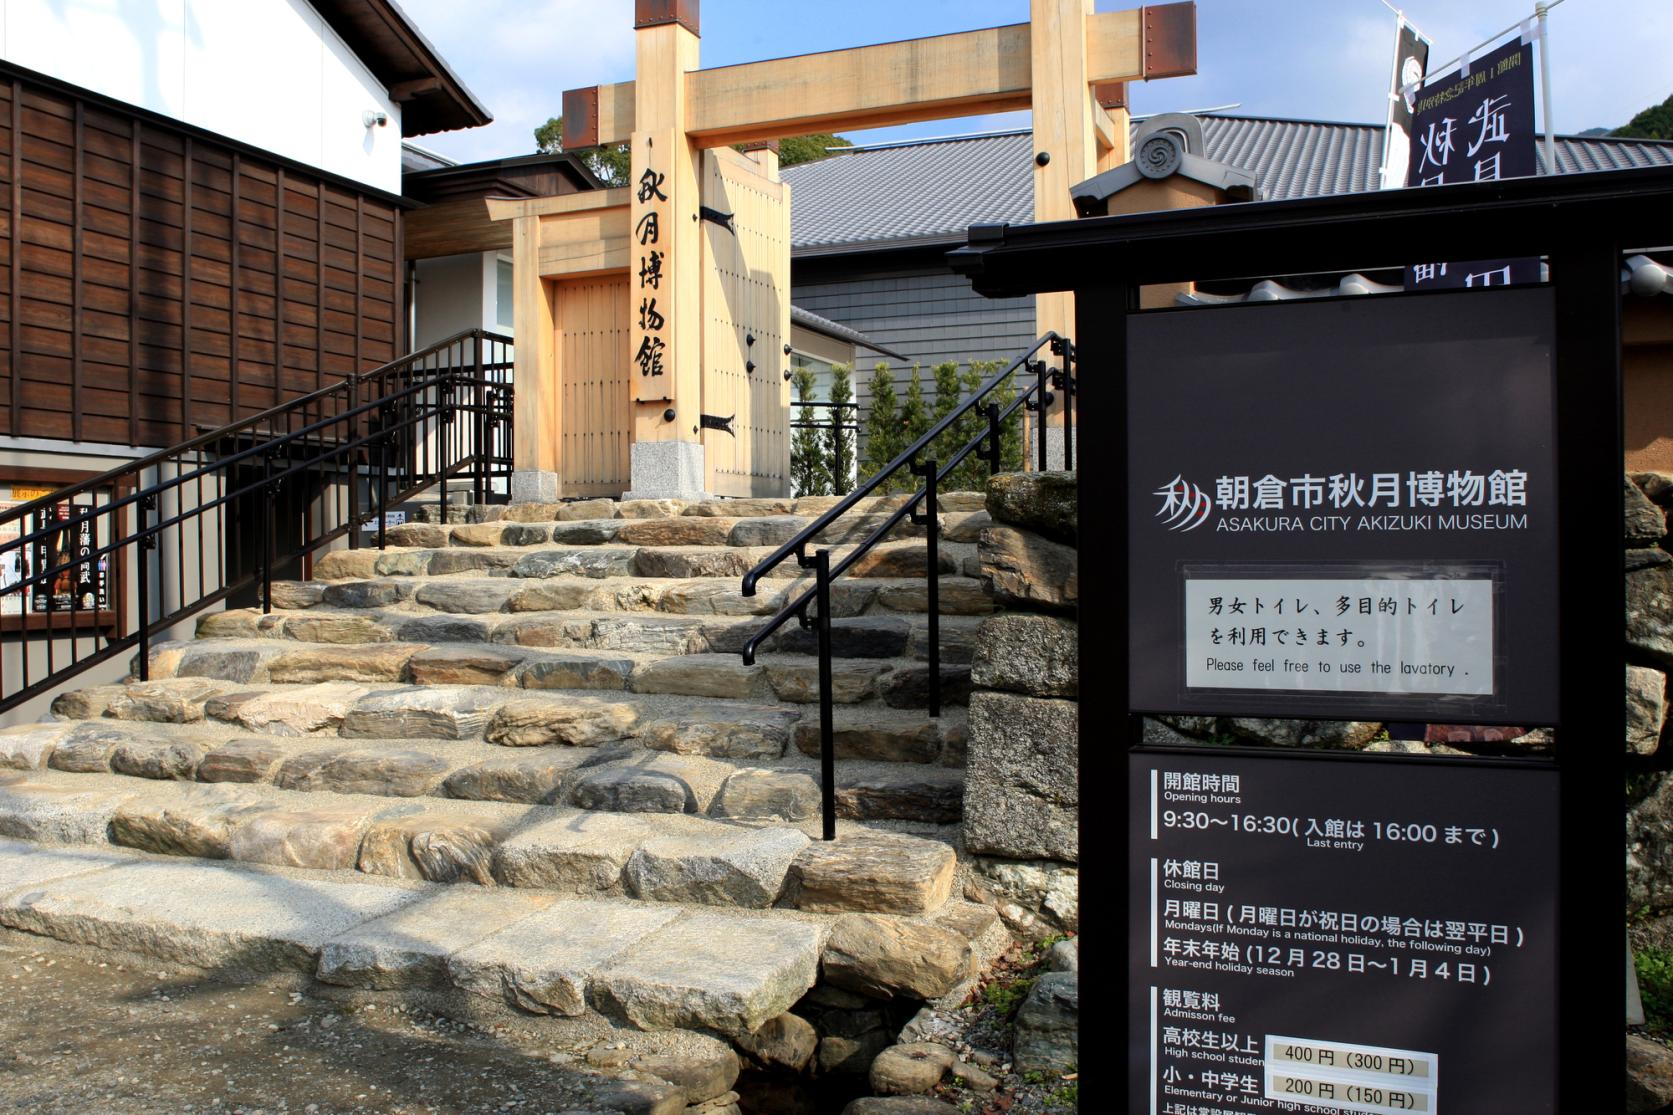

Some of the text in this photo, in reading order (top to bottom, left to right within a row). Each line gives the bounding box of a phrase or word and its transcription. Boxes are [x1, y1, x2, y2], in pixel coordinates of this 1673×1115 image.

[635, 168, 668, 377] 秋月博物館
[1215, 469, 1528, 510] 朝倉市秋月博物館
[1216, 514, 1528, 532] ASAKURA CITY AKIZUKI MUSEUM
[1208, 596, 1464, 616] 男女トイレ、多目的トイレ
[1210, 627, 1365, 647] を利用できます。
[1206, 658, 1244, 671] Please
[1253, 658, 1275, 672] feel
[1284, 659, 1309, 672] free
[1318, 661, 1331, 673] to
[1340, 663, 1361, 674] use
[1371, 660, 1392, 674] the
[1400, 661, 1455, 678] lavatory
[1163, 771, 1240, 794] 開館時間
[1164, 791, 1241, 804] Opening hours
[1307, 837, 1364, 851] Last entry
[1163, 859, 1219, 881] 休館日
[1164, 879, 1225, 894] Closing day
[1227, 924, 1269, 938] Monday
[1272, 928, 1281, 938] is
[1284, 930, 1291, 939] a
[1294, 930, 1338, 943] national
[1387, 937, 1406, 949] the
[1409, 940, 1462, 955] following
[1465, 945, 1491, 957] day)
[1165, 956, 1295, 977] Year-end holiday season
[1163, 988, 1220, 1012] 観覧料
[1164, 1007, 1236, 1023] Admisson fee
[1163, 1026, 1260, 1054] 高校生以上
[1164, 1046, 1265, 1067] High school studen
[1163, 1065, 1259, 1094] 小・中学生
[1164, 1084, 1223, 1103] Elementary
[1226, 1093, 1238, 1103] or
[1240, 1095, 1275, 1107] Junior
[1277, 1099, 1301, 1112] high
[1303, 1103, 1340, 1115] school
